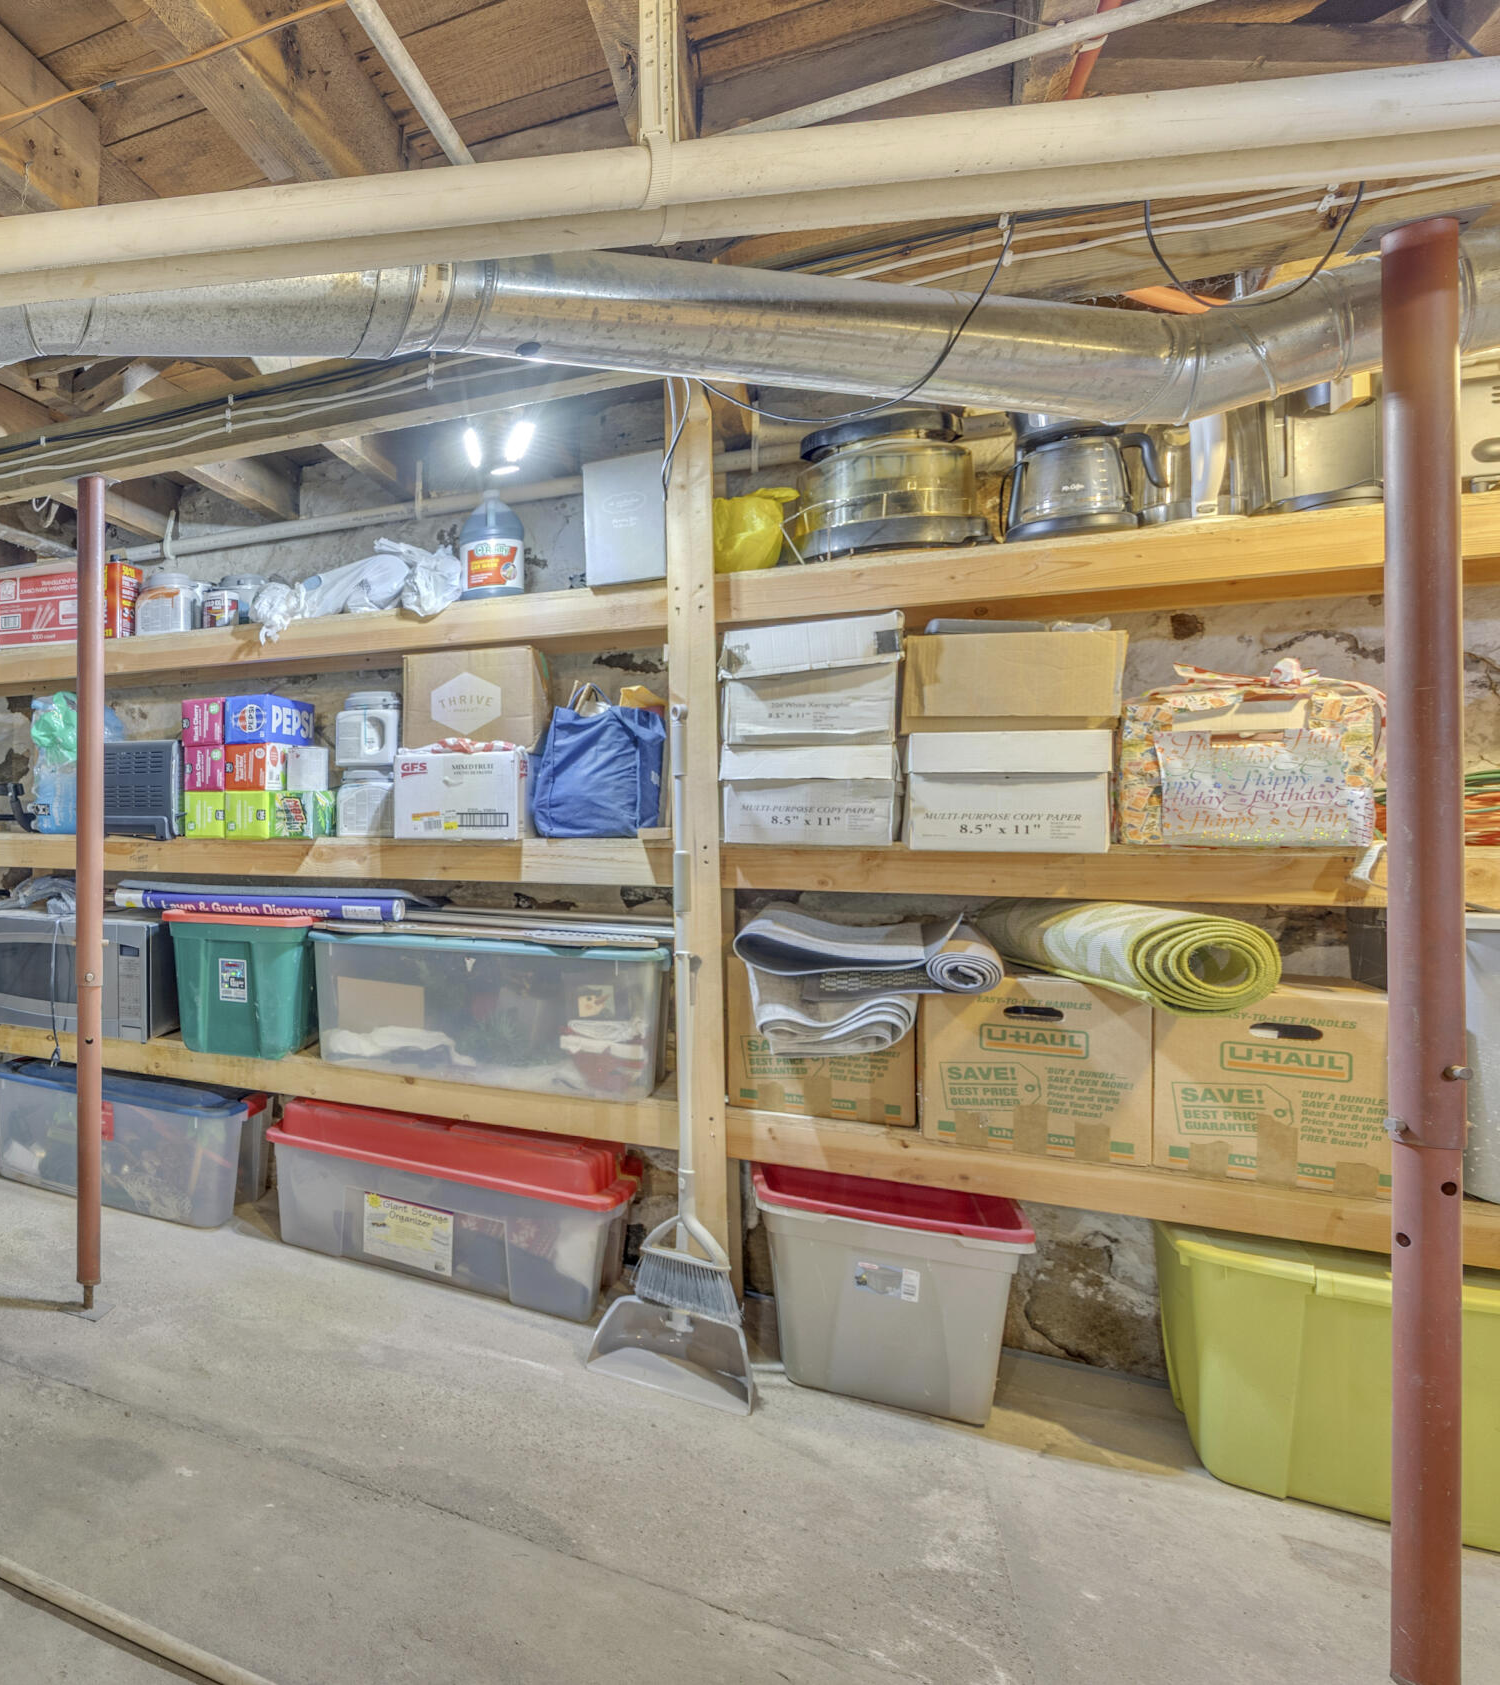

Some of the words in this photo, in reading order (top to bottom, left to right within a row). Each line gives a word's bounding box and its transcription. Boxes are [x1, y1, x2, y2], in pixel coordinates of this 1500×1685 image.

[438, 694, 493, 709] THRIVE
[271, 704, 314, 739] PEPSI
[401, 762, 427, 772] GFS
[1241, 770, 1312, 794] Happy
[1250, 786, 1340, 805] Birthday
[740, 804, 815, 814] MULTI-PURPOSE
[817, 806, 843, 815] COPY
[844, 807, 875, 815] PAPER
[771, 815, 799, 825] 8.5"
[804, 818, 811, 826] x
[817, 816, 841, 826] 11"
[924, 812, 1010, 821] MULTI-PURPOSE
[1013, 813, 1043, 821] COPY
[1045, 813, 1082, 822] PAPER
[1186, 808, 1259, 833] Happy
[959, 823, 992, 834] 8.5"
[998, 826, 1007, 834] x
[1014, 823, 1041, 834] 11"
[161, 900, 195, 911] Lawn
[199, 901, 209, 912] &
[212, 902, 259, 915] Garden
[262, 904, 330, 918] Dispenser
[977, 996, 1042, 1007] EASY-TO-LIFT
[1044, 1000, 1092, 1010] HANDLES
[1300, 1016, 1357, 1030] HANDLES
[987, 1028, 1081, 1048] U-HAUL
[750, 1058, 773, 1066] BEST
[776, 1058, 804, 1066] PRICE
[829, 1061, 852, 1069] Prices
[1229, 1046, 1343, 1070] U-HAUL
[750, 1067, 808, 1075] GUARANTEED
[948, 1066, 1016, 1080] SAVE!
[1047, 1075, 1071, 1084] SAVE
[1074, 1078, 1099, 1087] EVEN
[1102, 1081, 1134, 1090] MORE!
[950, 1087, 979, 1096] BEST
[982, 1087, 1017, 1096] PRICE
[1047, 1084, 1067, 1092] Beat
[1070, 1086, 1086, 1094] Our
[1088, 1087, 1120, 1097] Bundle
[1047, 1091, 1074, 1100] Prices
[1077, 1094, 1094, 1102] and
[1097, 1096, 1120, 1104] We'll
[1181, 1087, 1264, 1104] SAVE!
[951, 1097, 1020, 1106] GUARANTEED
[1069, 1100, 1084, 1109] You
[1300, 1099, 1331, 1109] SAVE
[1333, 1102, 1364, 1113] EVEN
[1047, 1107, 1069, 1115] FREE
[1072, 1109, 1103, 1118] Boxes!
[1184, 1109, 1217, 1120] BEST
[1223, 1110, 1258, 1121] PRIC
[1301, 1108, 1325, 1118] Beat
[1329, 1111, 1351, 1120] Our
[1354, 1113, 1388, 1125] Bundl
[1185, 1121, 1258, 1133] GUARANTEE
[1300, 1116, 1334, 1128] Prices
[1337, 1119, 1359, 1130] and
[1300, 1126, 1323, 1135] Give
[1327, 1128, 1346, 1138] You
[1372, 1134, 1382, 1142] in
[1300, 1134, 1327, 1144] FREE
[1331, 1137, 1368, 1148] Boxes!
[383, 1200, 408, 1213] Giant
[411, 1207, 448, 1224] Storage
[389, 1210, 432, 1227] Organizer
